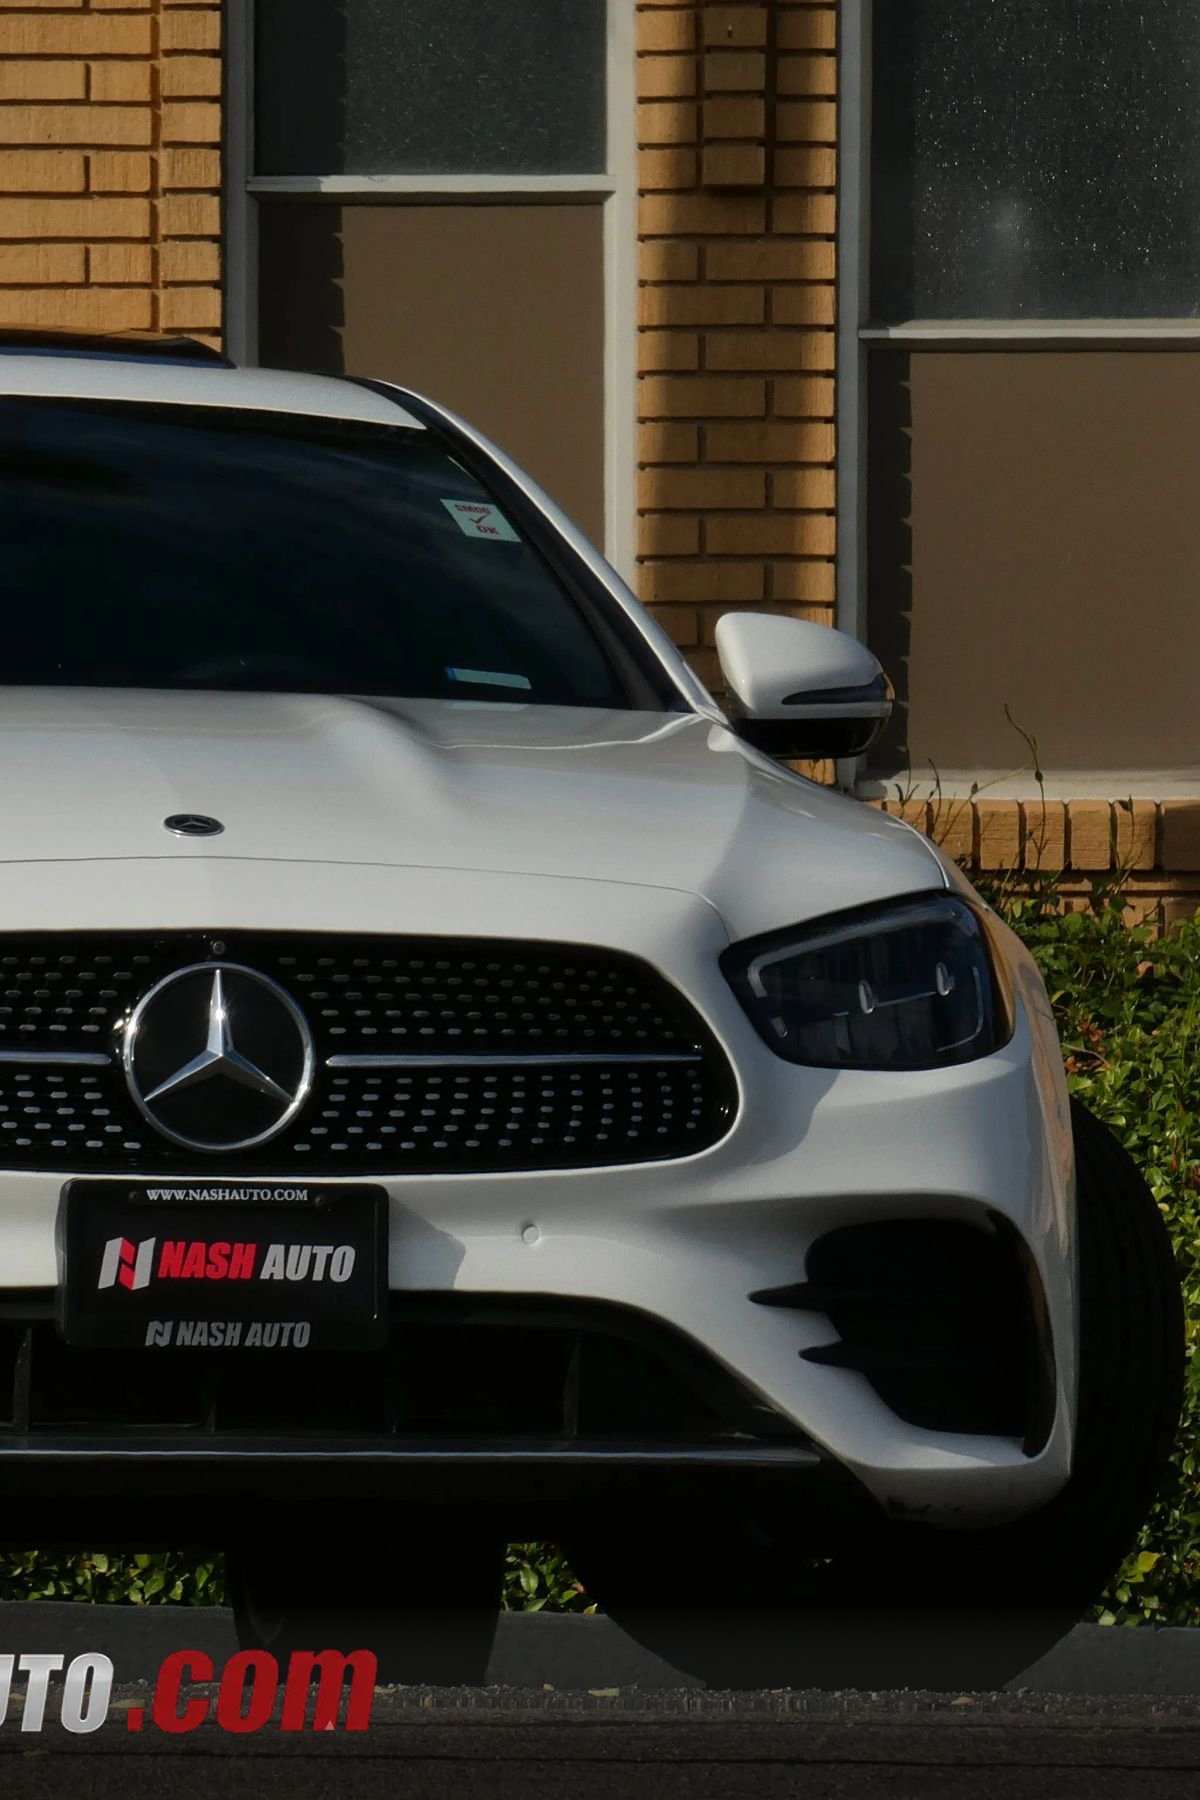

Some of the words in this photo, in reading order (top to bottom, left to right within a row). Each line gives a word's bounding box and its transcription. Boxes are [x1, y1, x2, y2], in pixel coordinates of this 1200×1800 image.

[476, 525, 500, 535] OK
[146, 1188, 308, 1201] WWW.NASHAUTO.COM
[157, 1241, 257, 1280] NASH
[259, 1243, 356, 1283] AUTO
[176, 1320, 243, 1347] NASH
[244, 1321, 311, 1348] AUTO
